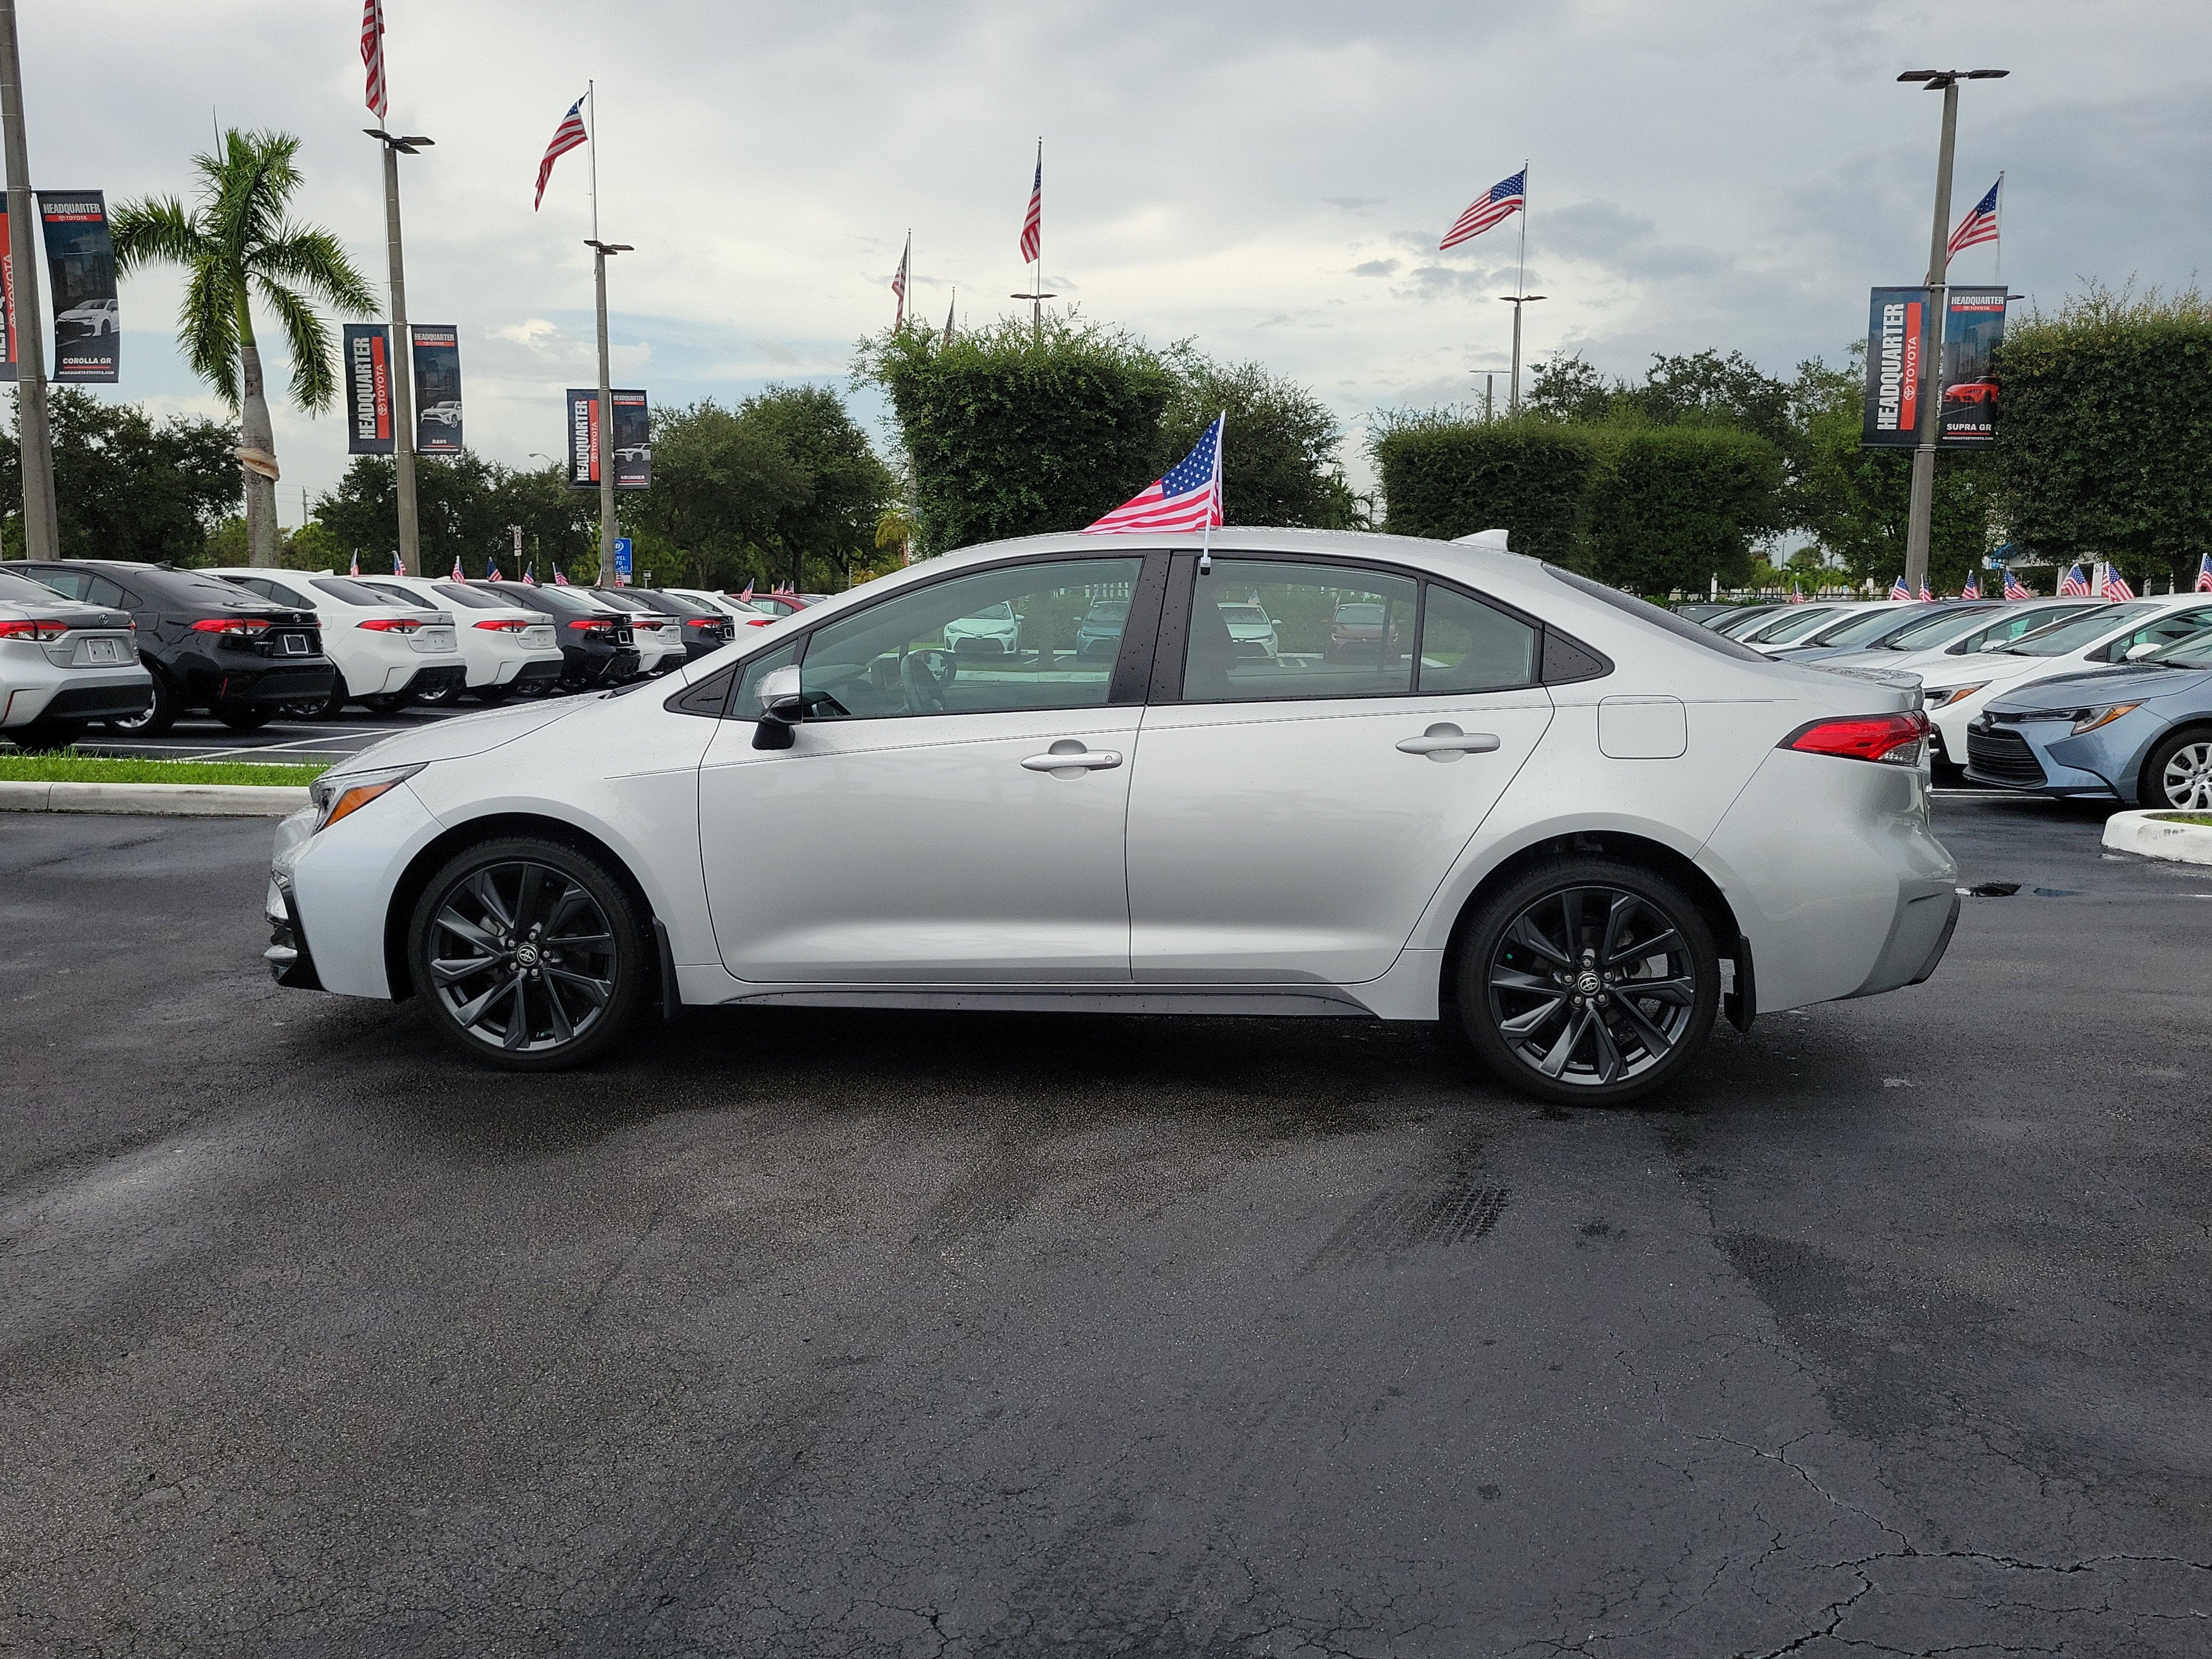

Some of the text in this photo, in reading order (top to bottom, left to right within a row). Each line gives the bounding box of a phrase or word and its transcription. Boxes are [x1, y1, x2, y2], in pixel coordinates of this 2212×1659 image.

[43, 202, 101, 215] HEADQUARTER
[1951, 296, 2004, 306] HEADQUARTER
[415, 333, 455, 341] HEADQUARTER
[1877, 303, 1904, 430] HEADQUARTER
[1906, 337, 1917, 385] TOYOTA
[353, 337, 376, 439] HEADQUARTER
[375, 364, 386, 402] TOYOTA
[574, 400, 590, 481] HEADQUARTER
